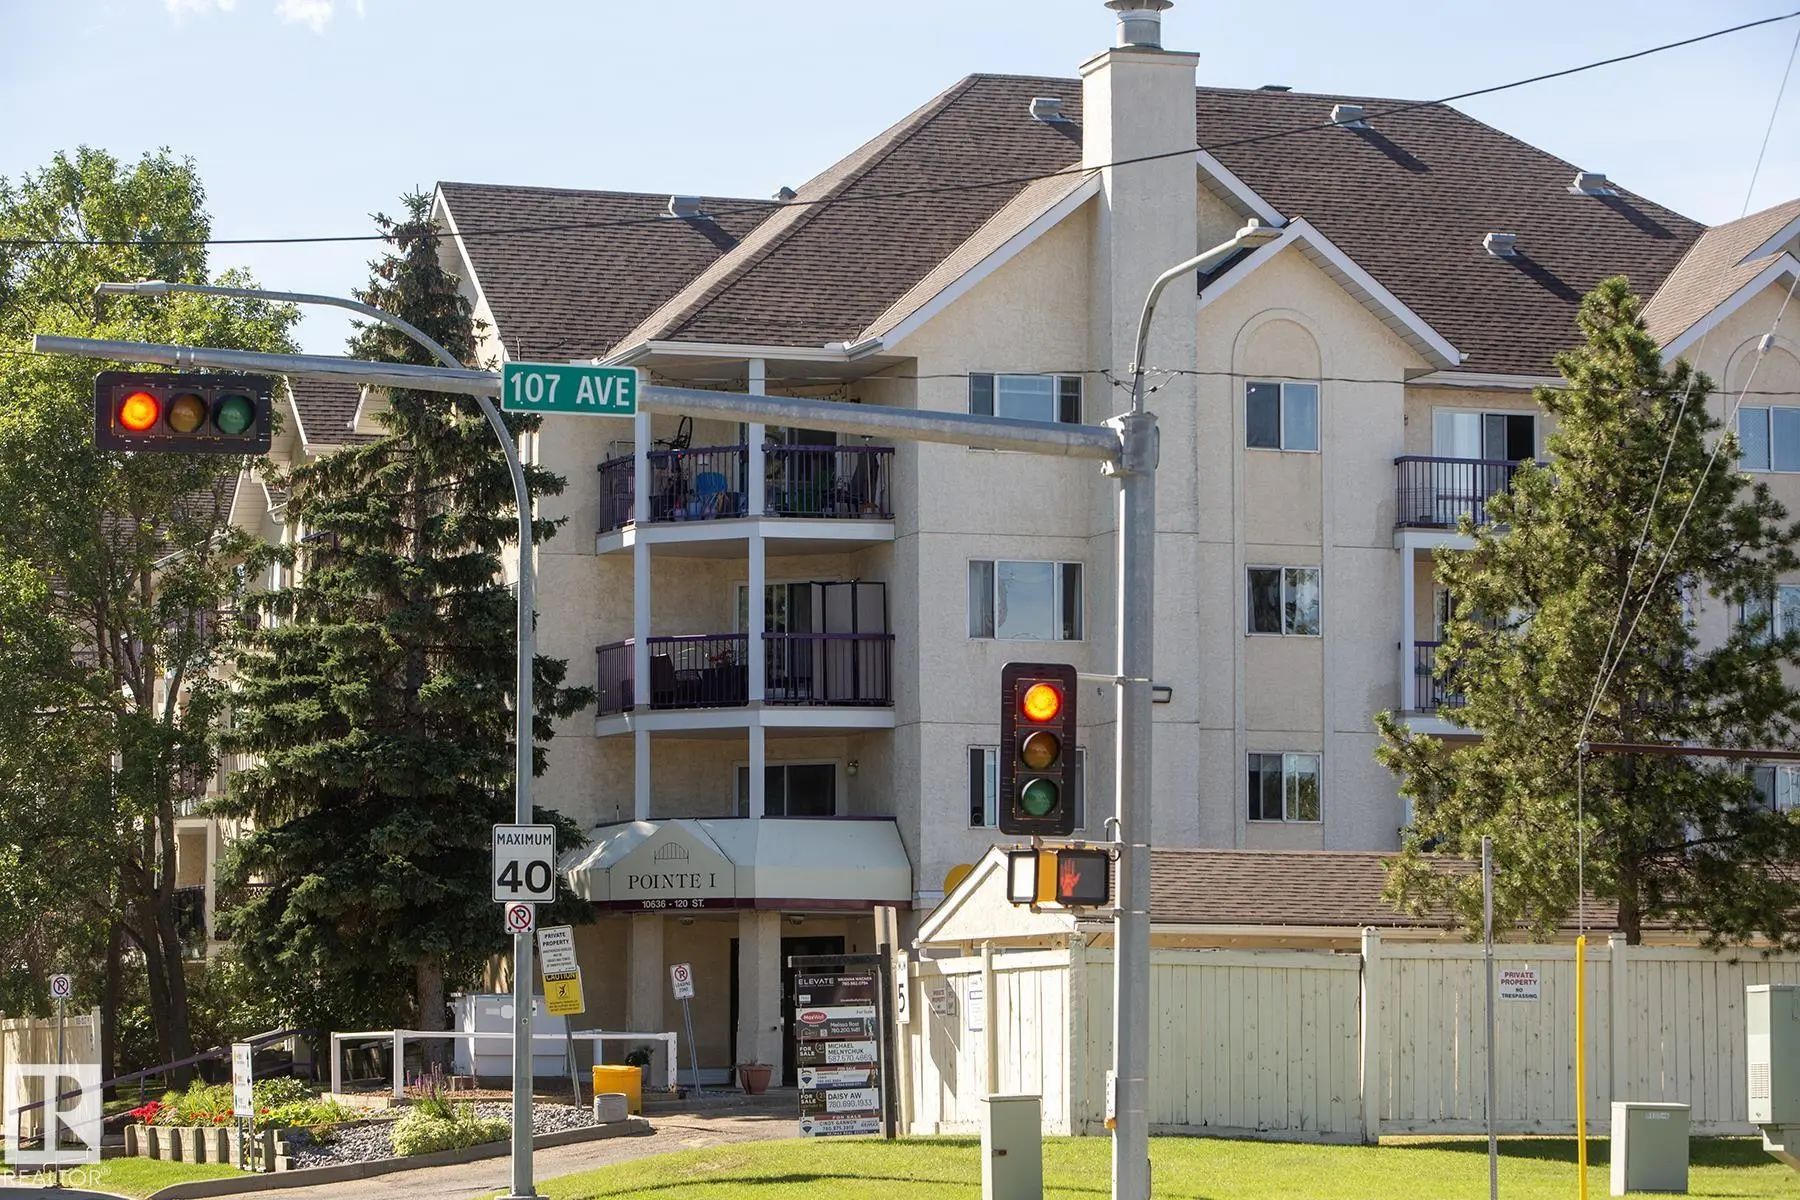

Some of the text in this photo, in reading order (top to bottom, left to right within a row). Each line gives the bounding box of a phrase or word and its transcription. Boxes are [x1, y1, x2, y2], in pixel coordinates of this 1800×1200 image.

[510, 372, 630, 406] 107 AVE
[496, 833, 552, 893] MAXIMUM 40
[628, 873, 716, 889] POINTE I
[642, 900, 666, 909] 10636
[675, 899, 688, 908] 120
[691, 898, 705, 908] ST.
[542, 939, 570, 947] PROPERTY
[546, 973, 577, 982] CAUTION
